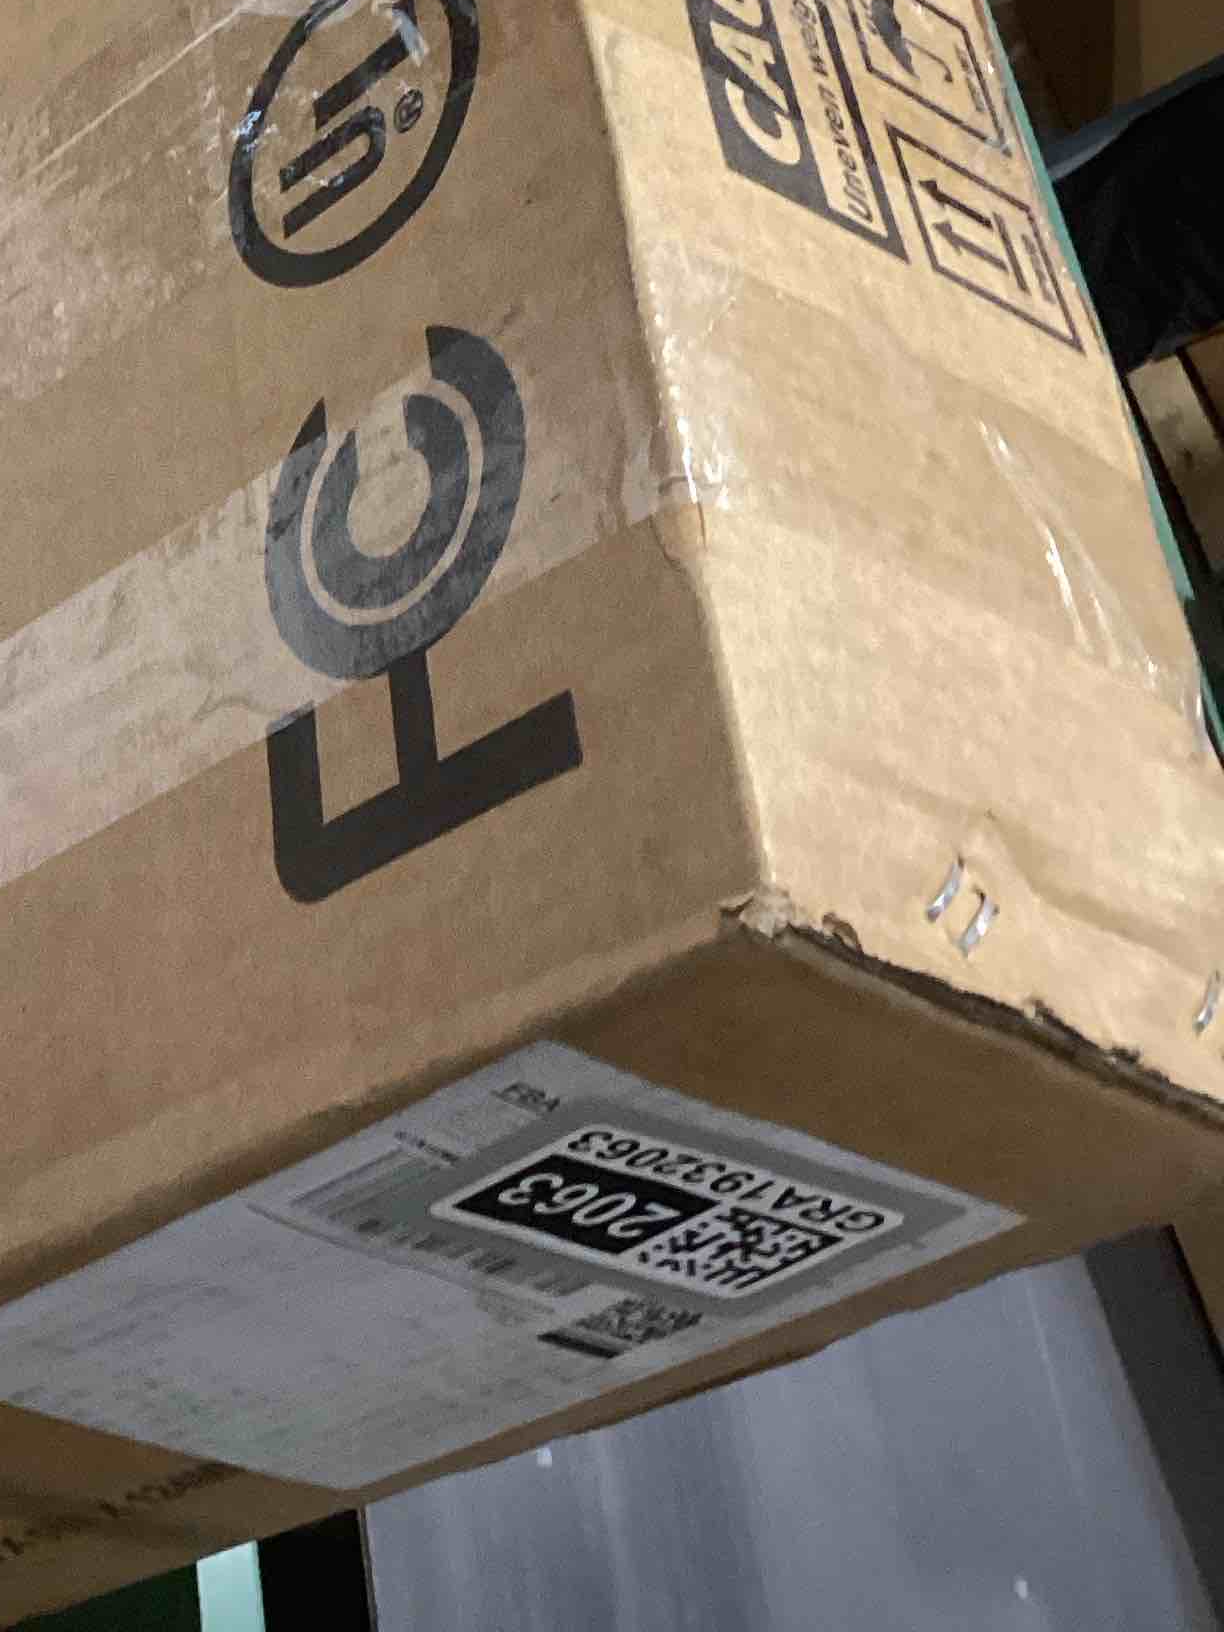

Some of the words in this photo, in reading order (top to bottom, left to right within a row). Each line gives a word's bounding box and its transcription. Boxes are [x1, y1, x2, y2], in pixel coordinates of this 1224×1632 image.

[817, 83, 874, 224] Uneven
[497, 1172, 682, 1240] 2063
[568, 1130, 886, 1234] GRA1932063
